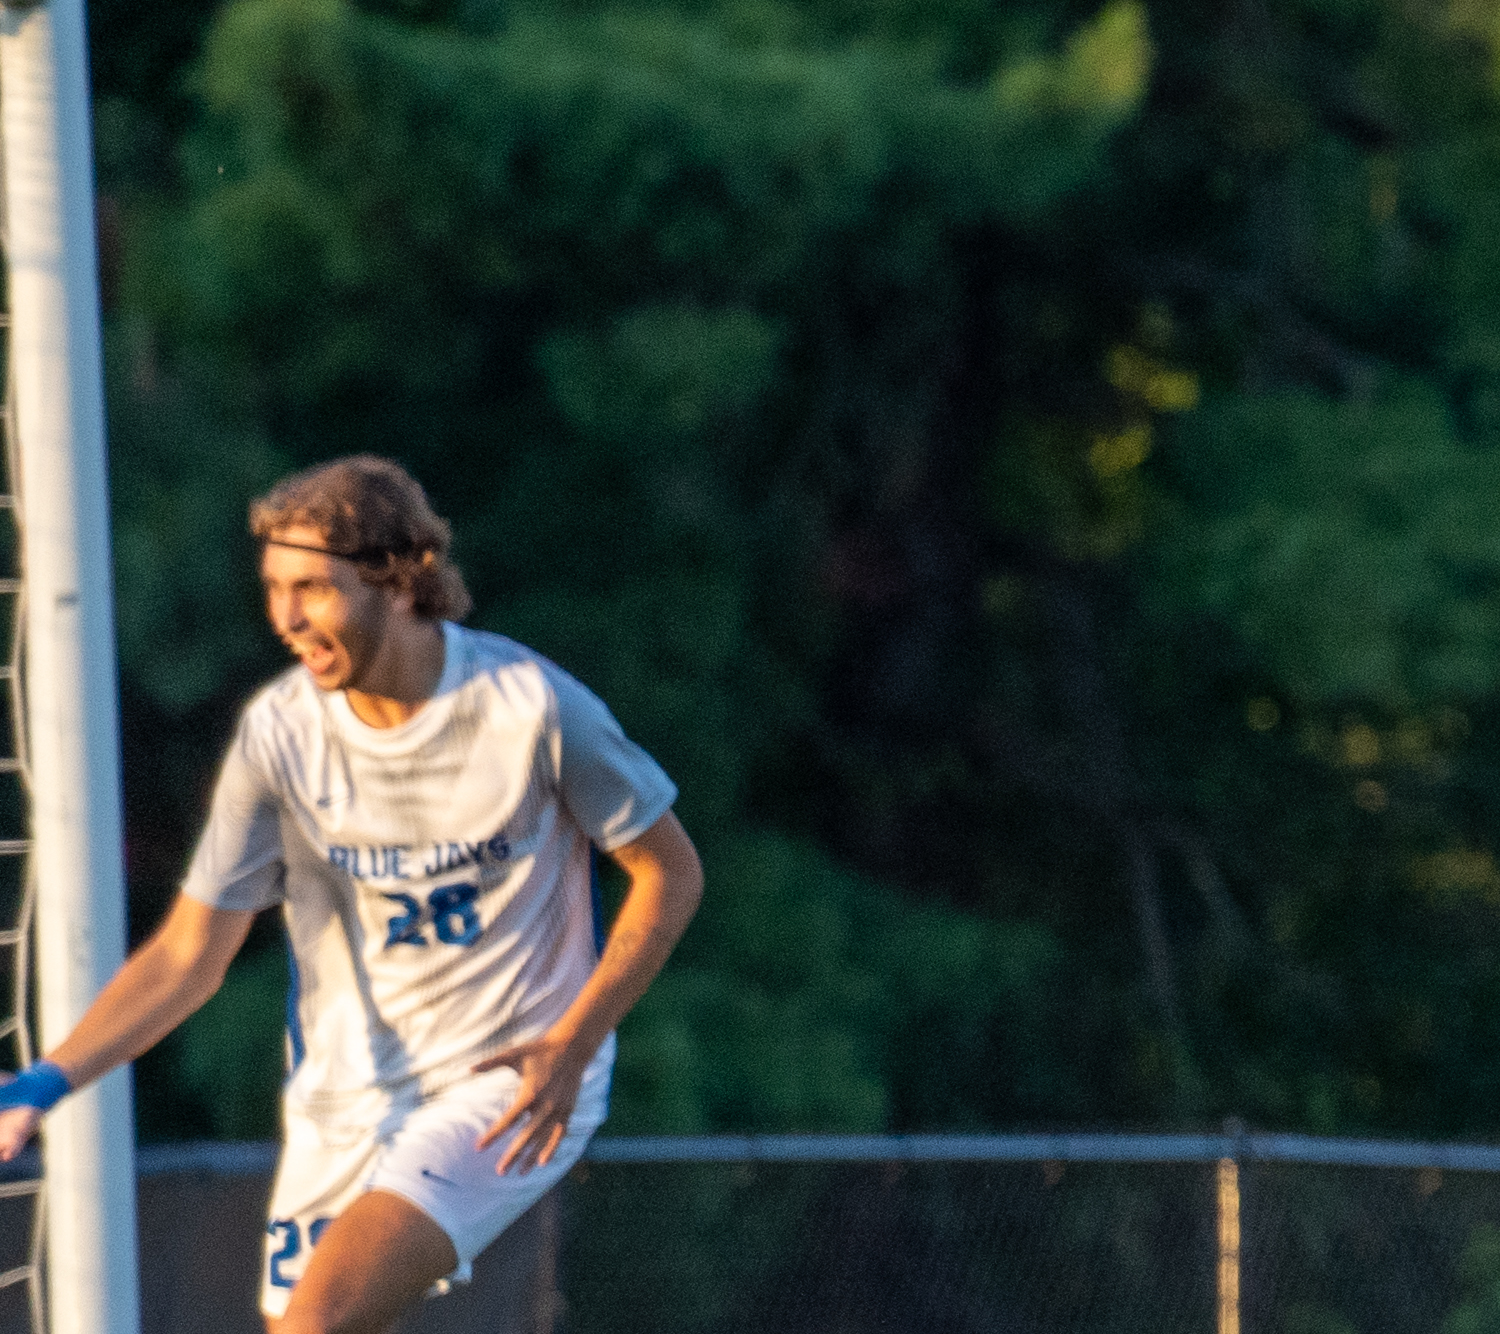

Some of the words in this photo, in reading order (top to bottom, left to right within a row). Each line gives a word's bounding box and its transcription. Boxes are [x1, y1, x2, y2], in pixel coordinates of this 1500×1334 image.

[328, 844, 410, 880] BLUE
[381, 883, 482, 948] 28
[266, 1216, 334, 1289] 2
